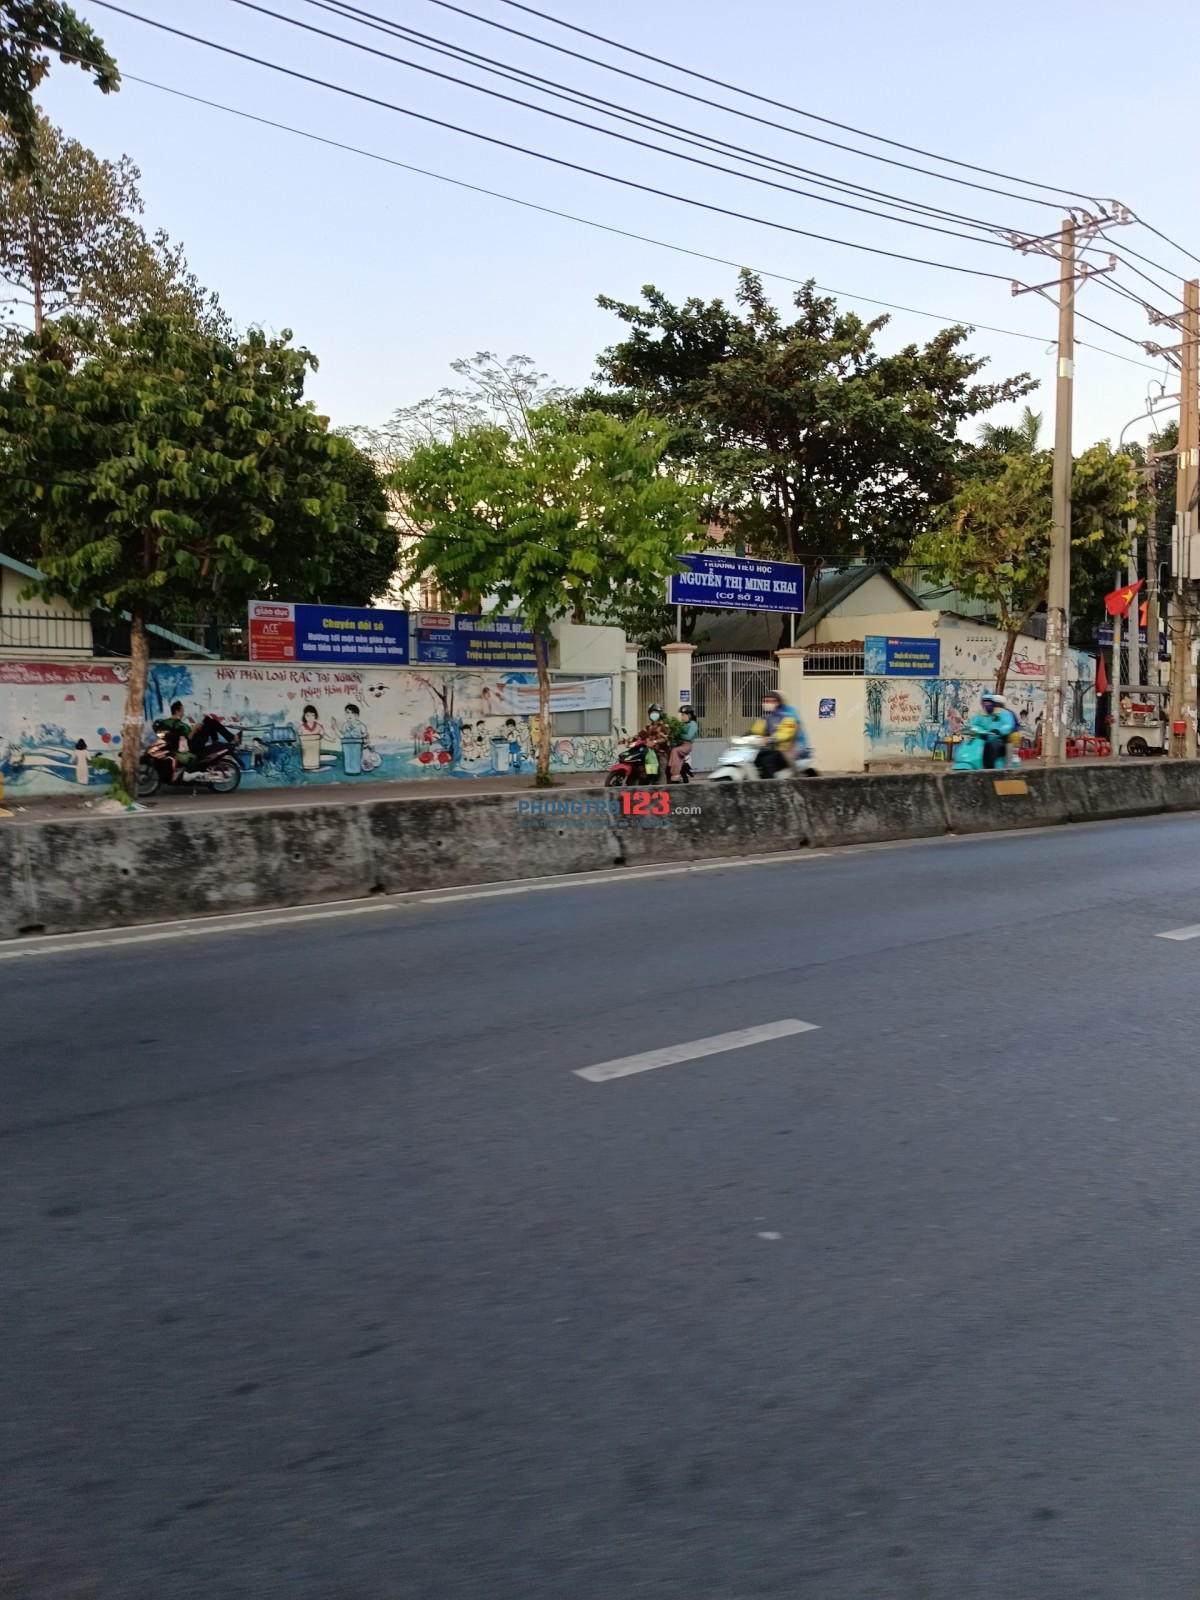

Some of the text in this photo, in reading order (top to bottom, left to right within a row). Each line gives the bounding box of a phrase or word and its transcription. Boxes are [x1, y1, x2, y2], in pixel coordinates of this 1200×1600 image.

[756, 566, 773, 574] HỌC
[679, 568, 797, 594] NGUYỄN THỊ MINH KHAI
[263, 623, 279, 633] ACE
[322, 618, 384, 631] Chuyển đổi số
